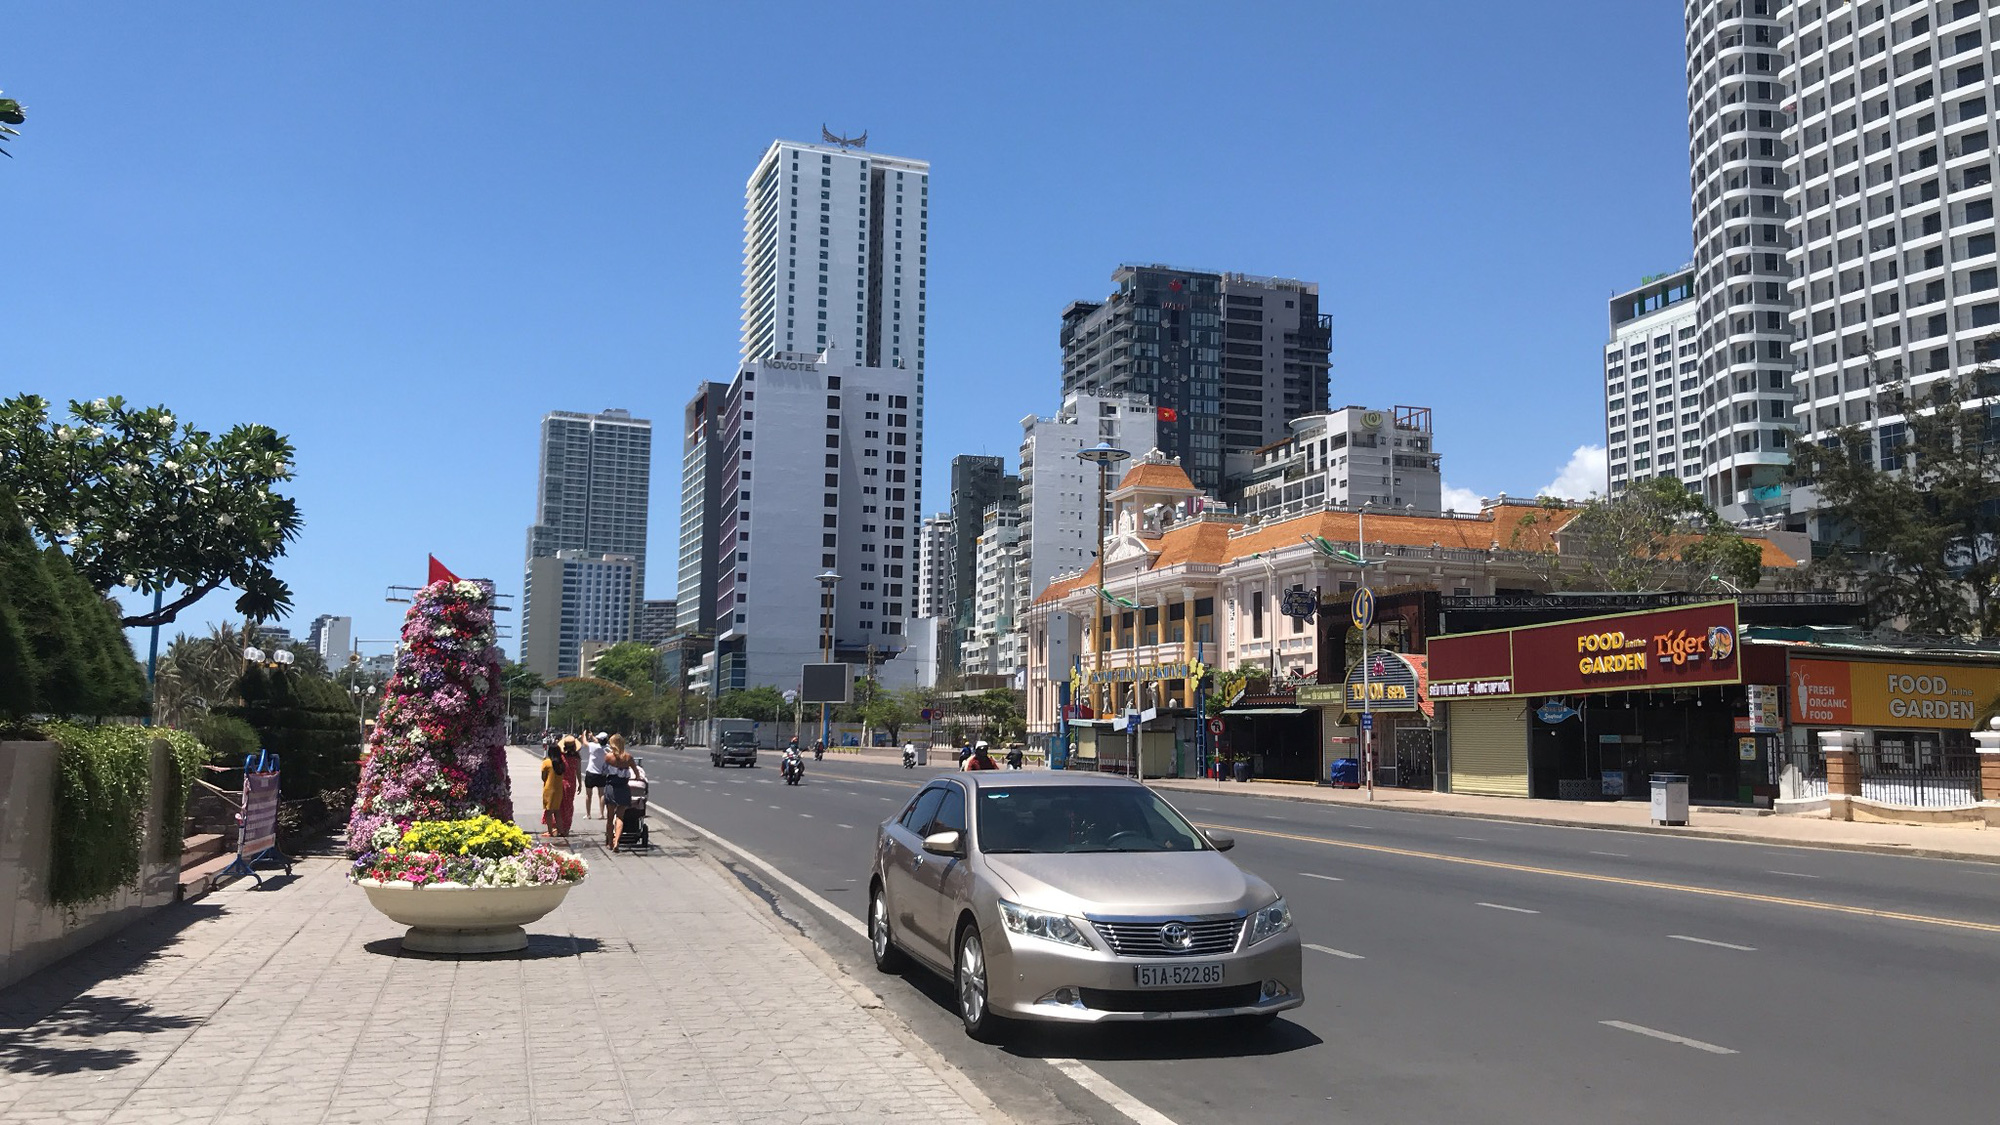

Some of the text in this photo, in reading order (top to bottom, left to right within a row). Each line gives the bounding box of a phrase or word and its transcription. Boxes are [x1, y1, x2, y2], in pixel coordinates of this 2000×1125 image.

[764, 359, 819, 373] NOVOTEL
[1578, 631, 1625, 652] FOOD
[1653, 629, 1706, 665] Tiger
[1579, 652, 1647, 674] GARDEN
[1387, 685, 1407, 699] SPA
[1808, 685, 1835, 696] FRESH
[1887, 674, 1973, 696] FOOD in the
[1809, 698, 1847, 709] ORGANIC
[1889, 698, 1975, 720] GARDEN
[1809, 711, 1834, 720] FOOD
